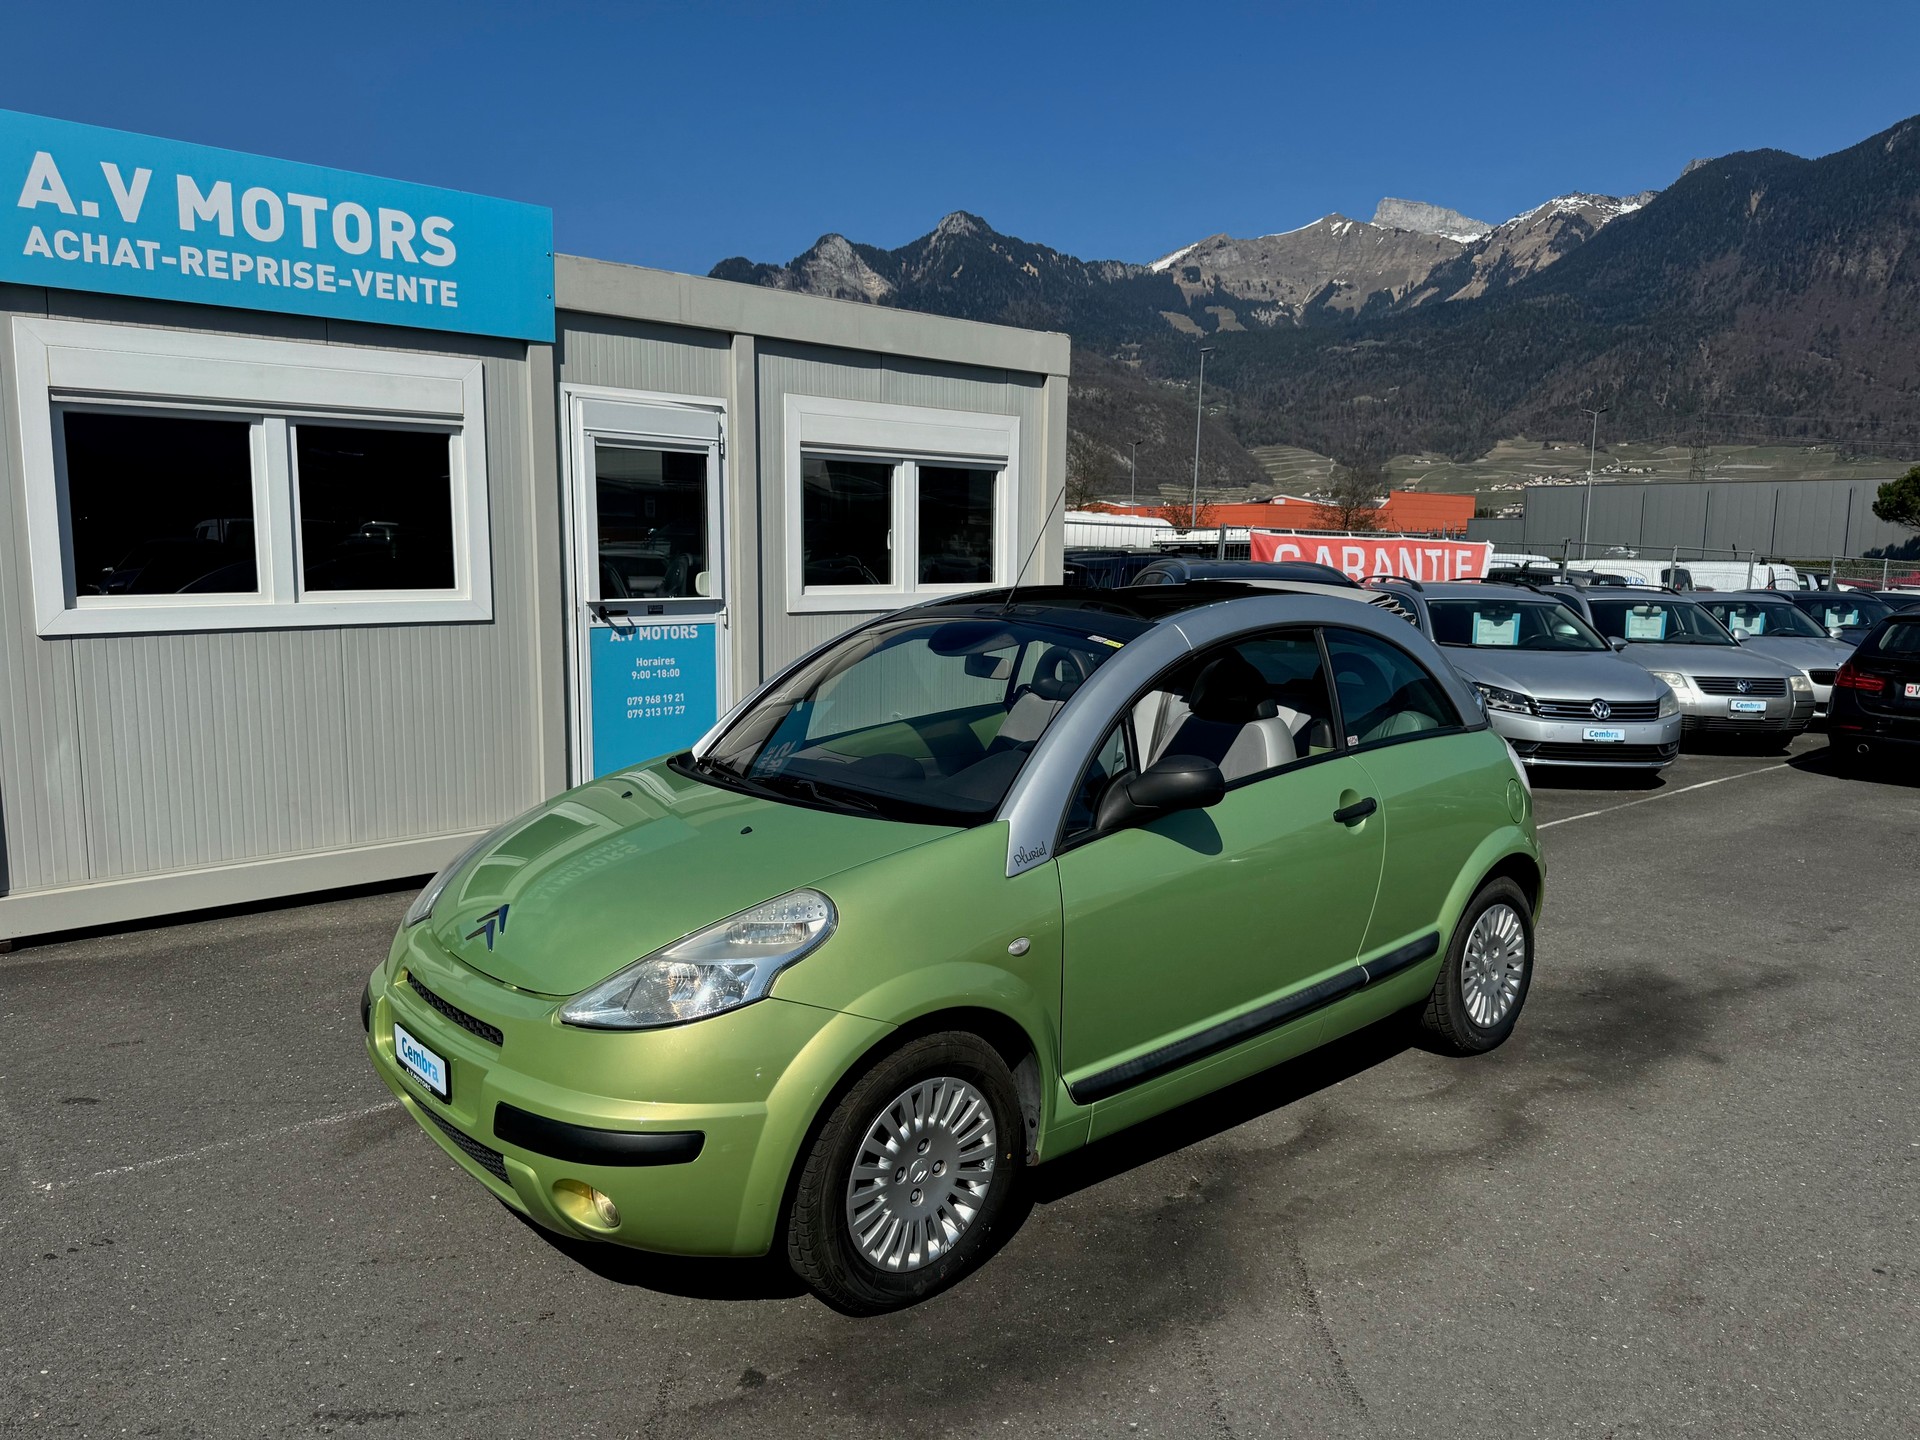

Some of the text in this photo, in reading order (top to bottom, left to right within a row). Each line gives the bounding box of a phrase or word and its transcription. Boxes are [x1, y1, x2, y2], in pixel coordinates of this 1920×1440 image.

[17, 150, 457, 268] A.V MOTORS
[23, 225, 458, 309] ACHAT-REPRISE-VENTE
[639, 624, 698, 641] MOTORS
[636, 656, 676, 667] Horaires
[627, 692, 684, 706] 079 968 19 21
[627, 705, 685, 719] 079 313 17 27
[1589, 730, 1619, 738] Cembra
[401, 1036, 440, 1083] Cembra
